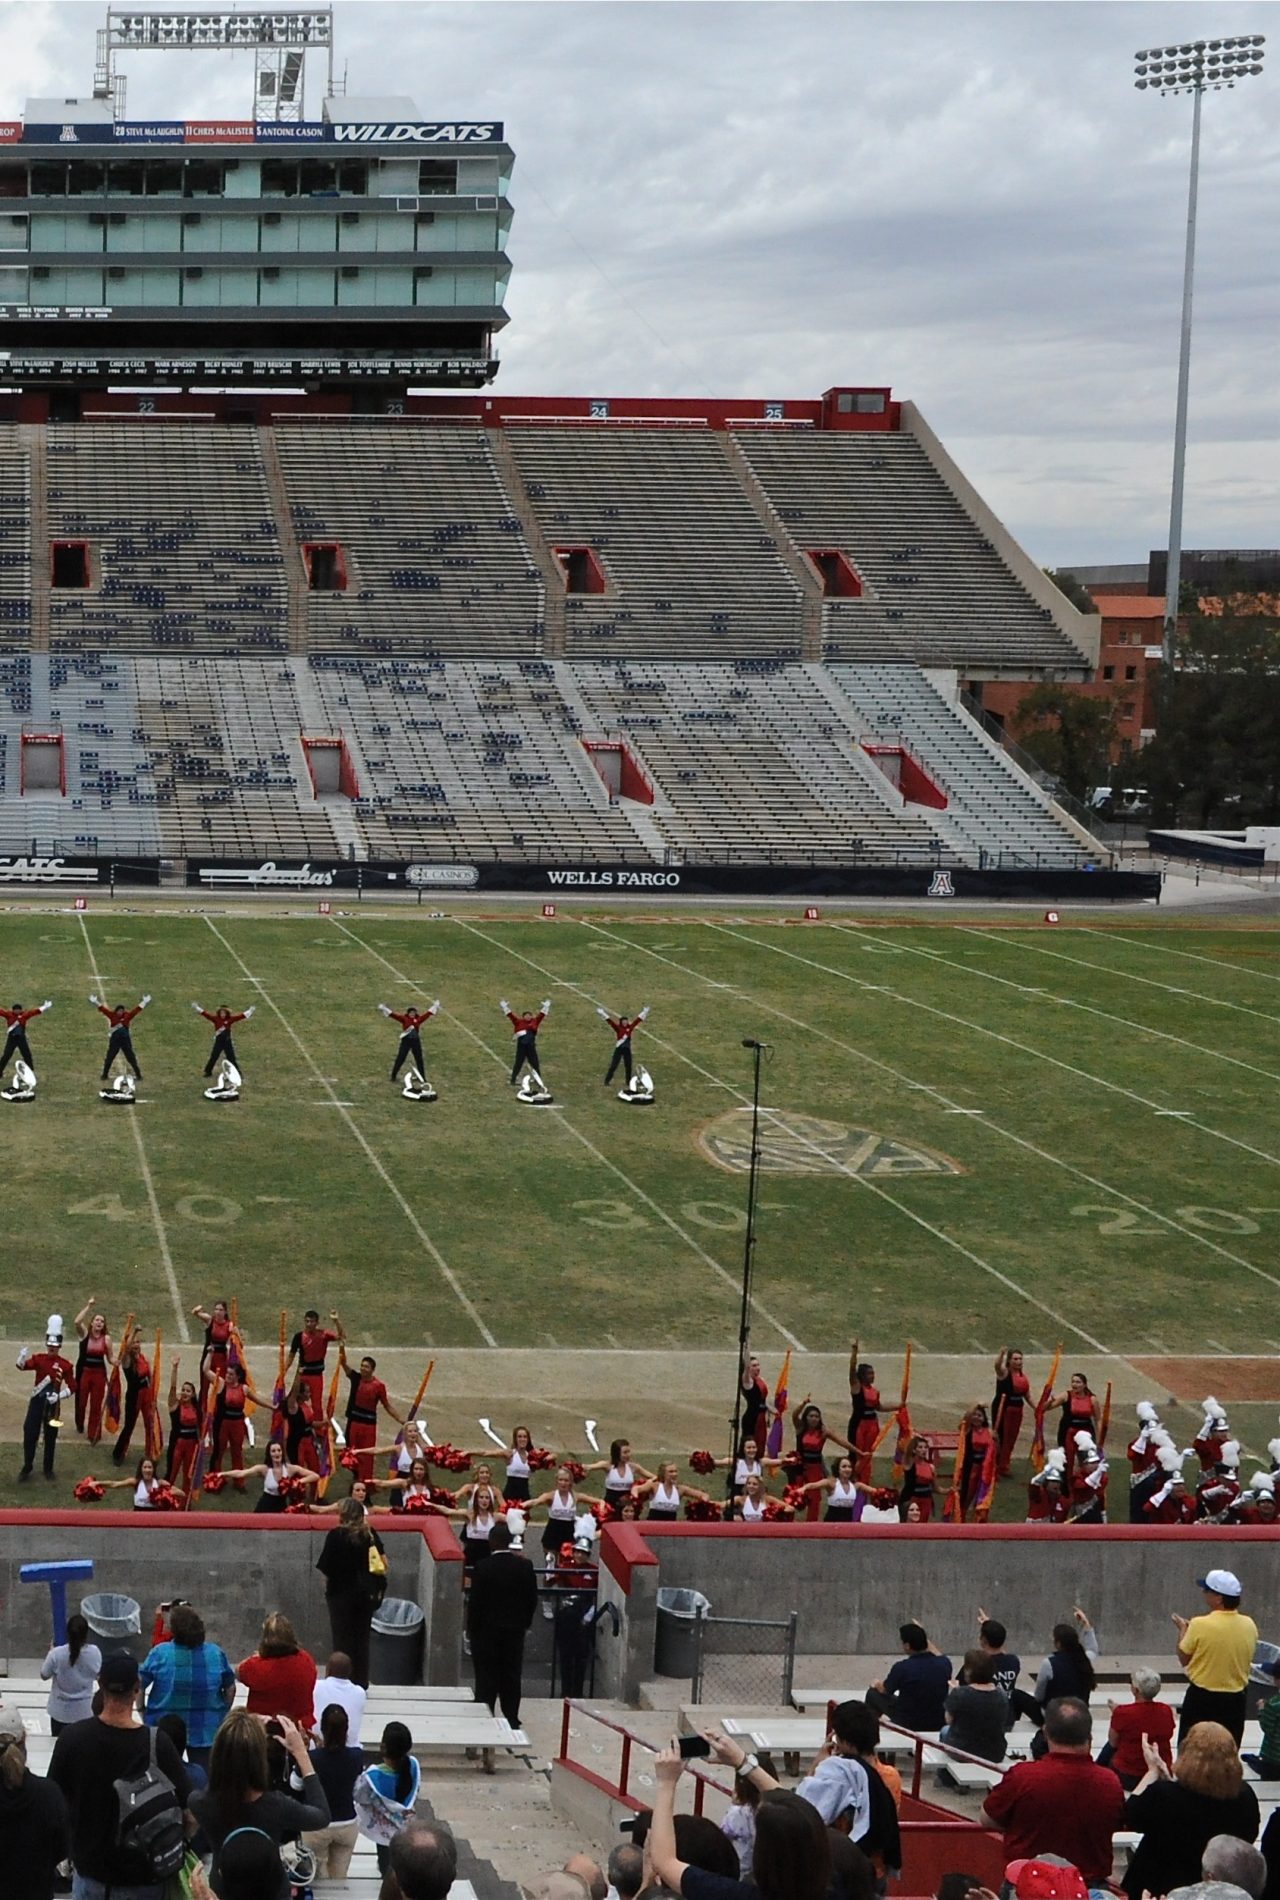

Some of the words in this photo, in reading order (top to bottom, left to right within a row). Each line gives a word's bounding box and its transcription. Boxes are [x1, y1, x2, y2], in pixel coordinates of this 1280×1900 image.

[126, 127, 143, 136] STEVE
[193, 127, 215, 136] CHRIS
[262, 127, 295, 136] ANTOINE
[296, 127, 323, 137] CASON
[334, 125, 495, 141] WILDCATS
[591, 407, 608, 417] 24
[766, 409, 782, 420] 25
[547, 871, 613, 885] WELLS
[617, 872, 680, 886] FARGO
